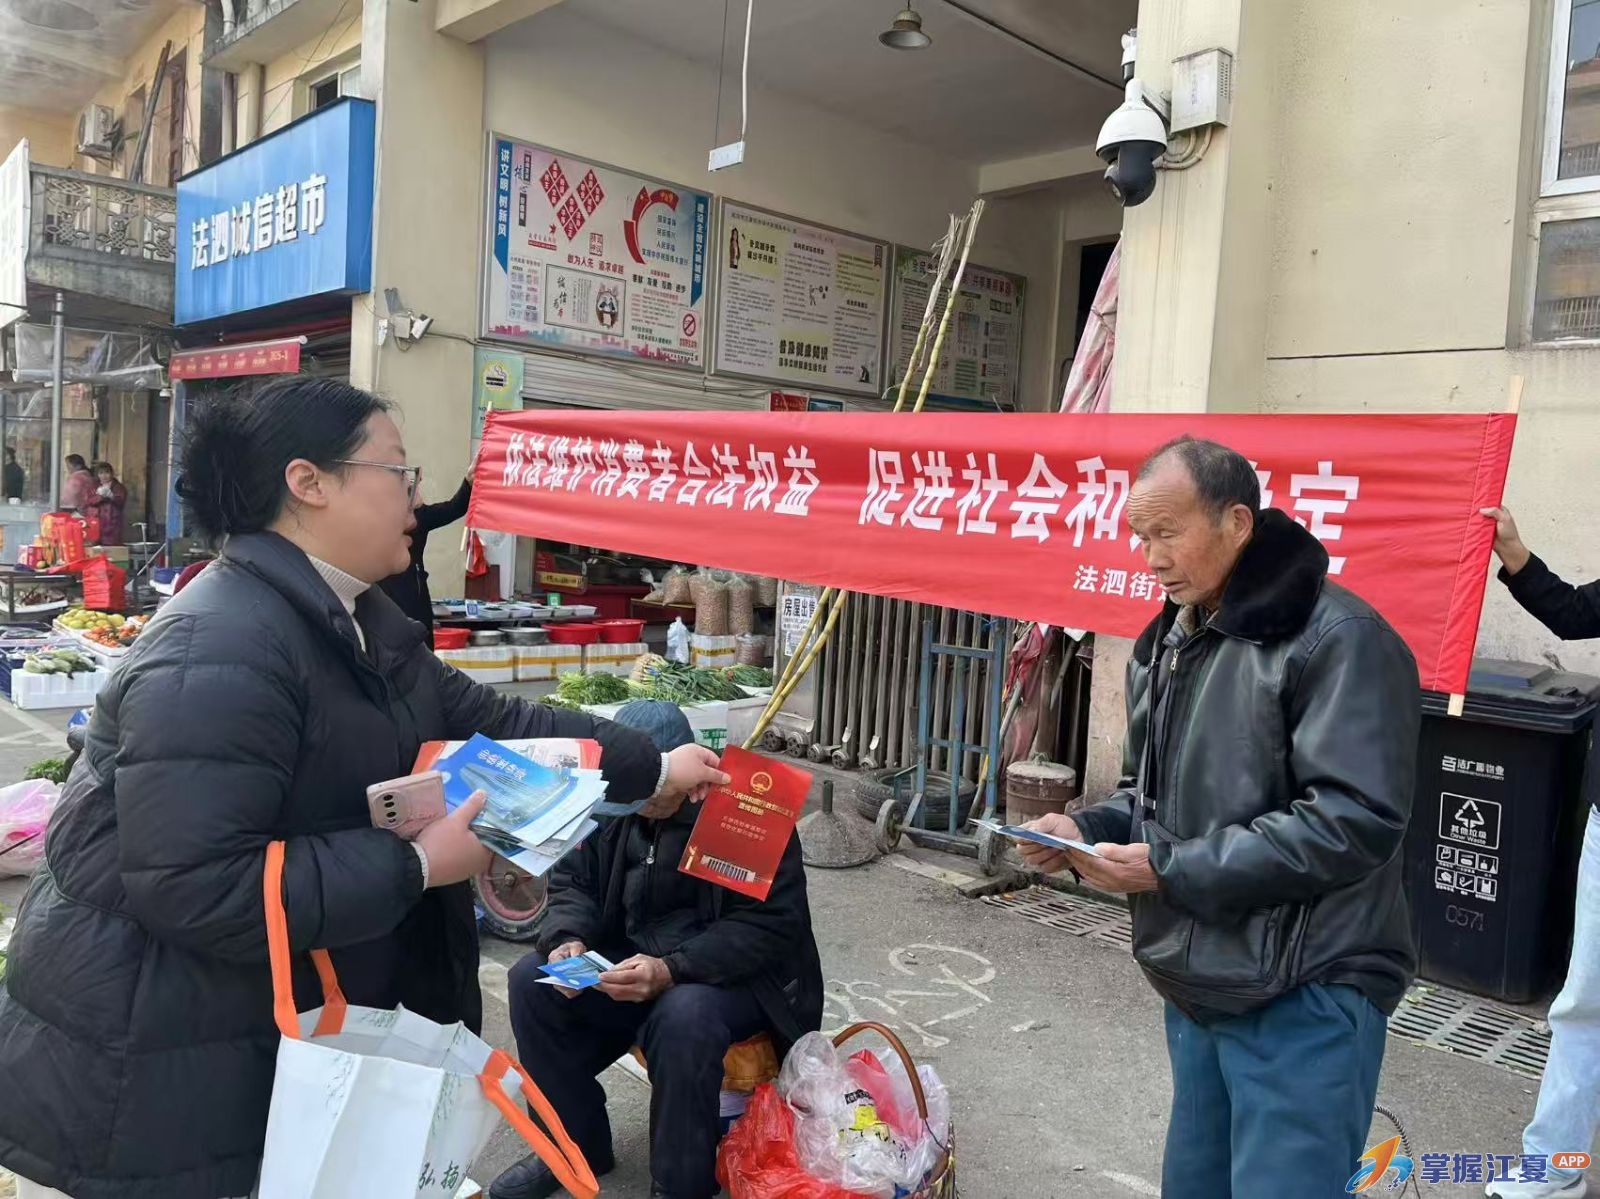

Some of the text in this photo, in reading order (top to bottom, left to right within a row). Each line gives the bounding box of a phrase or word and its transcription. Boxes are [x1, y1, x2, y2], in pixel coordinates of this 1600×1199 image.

[499, 148, 511, 192] 讲文明
[190, 173, 329, 270] 法泗诚信超市
[502, 432, 1360, 576] 依法维护消费者合法权益 促进社会和定
[1073, 564, 1168, 602] 法泗街
[1450, 824, 1487, 840] 其他垃圾
[1467, 835, 1487, 845] Waste
